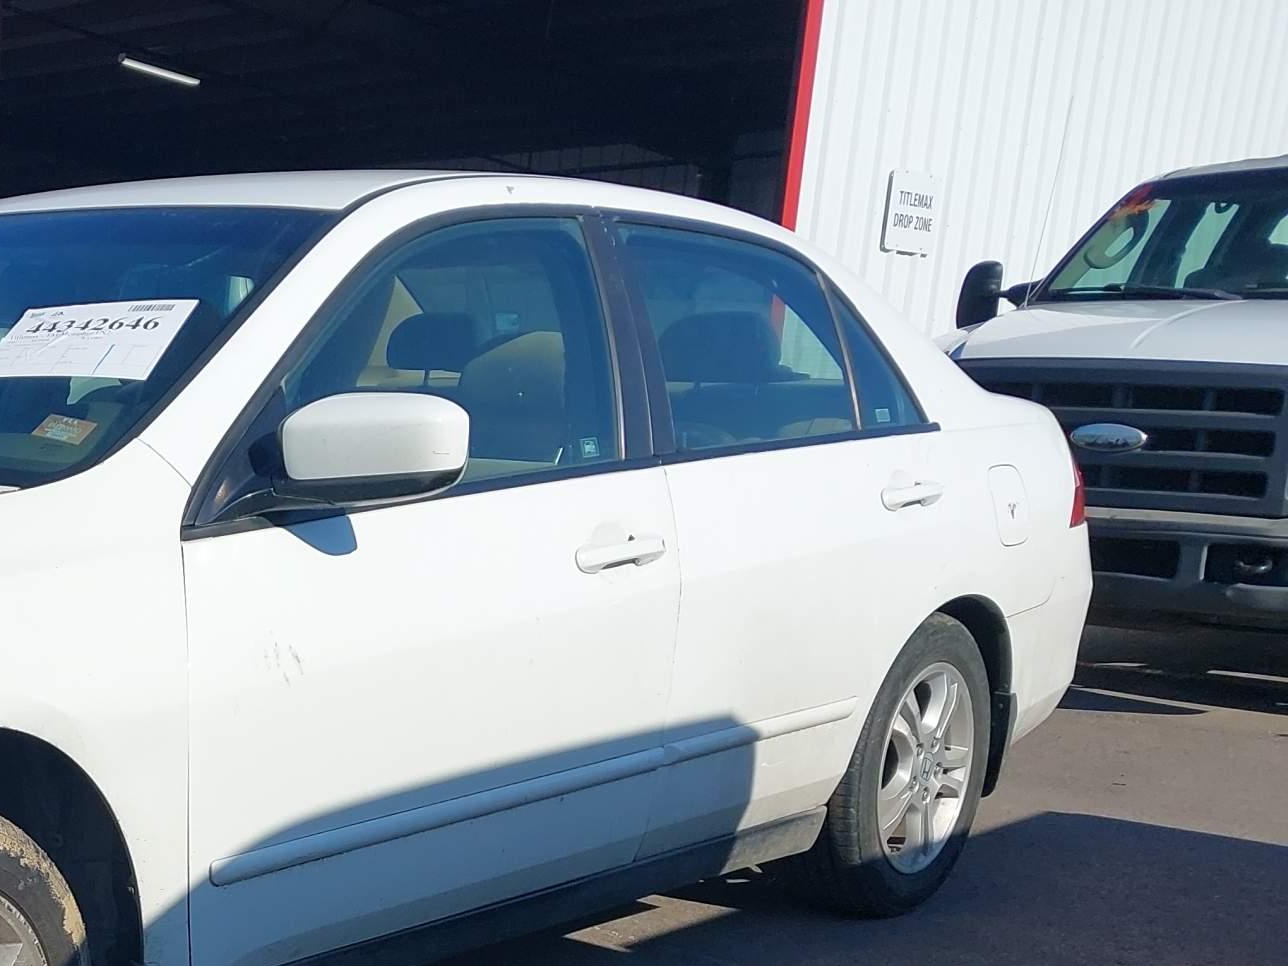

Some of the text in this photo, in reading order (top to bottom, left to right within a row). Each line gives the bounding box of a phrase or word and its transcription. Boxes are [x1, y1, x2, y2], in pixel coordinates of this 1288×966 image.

[899, 190, 933, 209] TITLEMAX
[893, 213, 933, 232] DROP ZONE
[26, 316, 160, 334] 44342646
